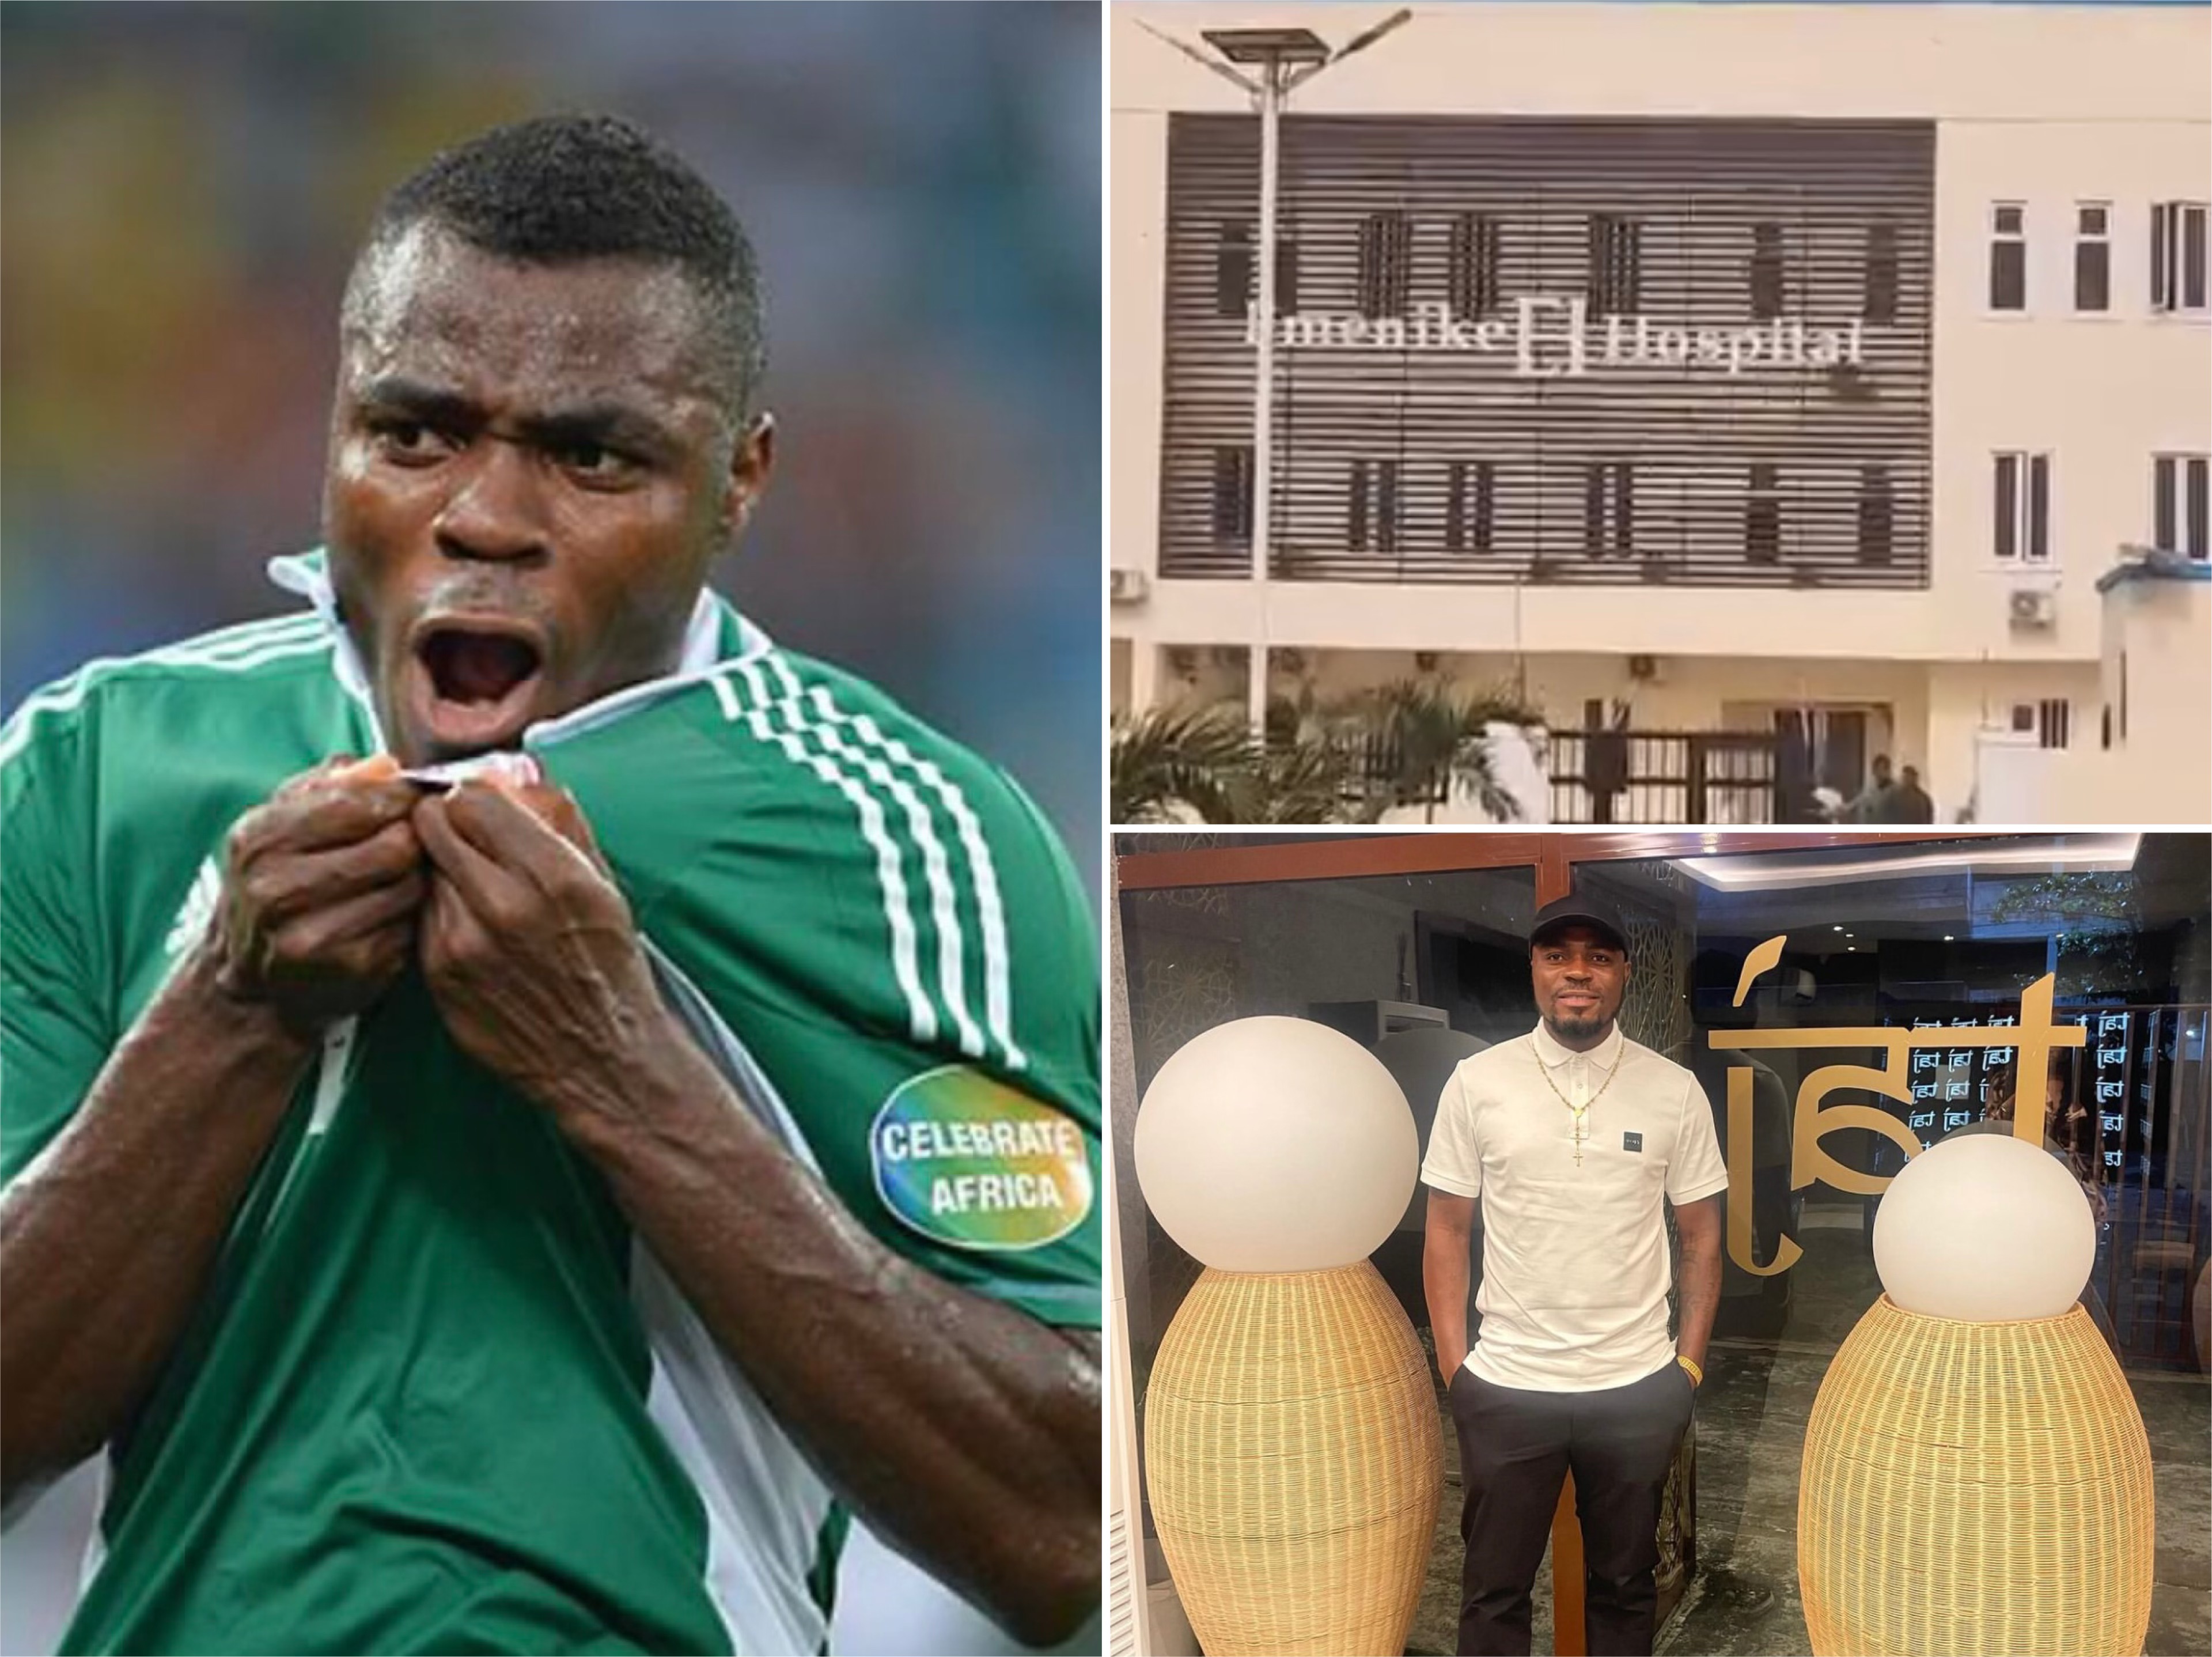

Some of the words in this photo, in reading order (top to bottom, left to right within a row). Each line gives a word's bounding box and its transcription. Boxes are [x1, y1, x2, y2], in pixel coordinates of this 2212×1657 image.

[1604, 314, 1864, 373] Hospital
[881, 1117, 1077, 1162] CELEBRATE
[930, 1173, 1064, 1216] AFRICA
